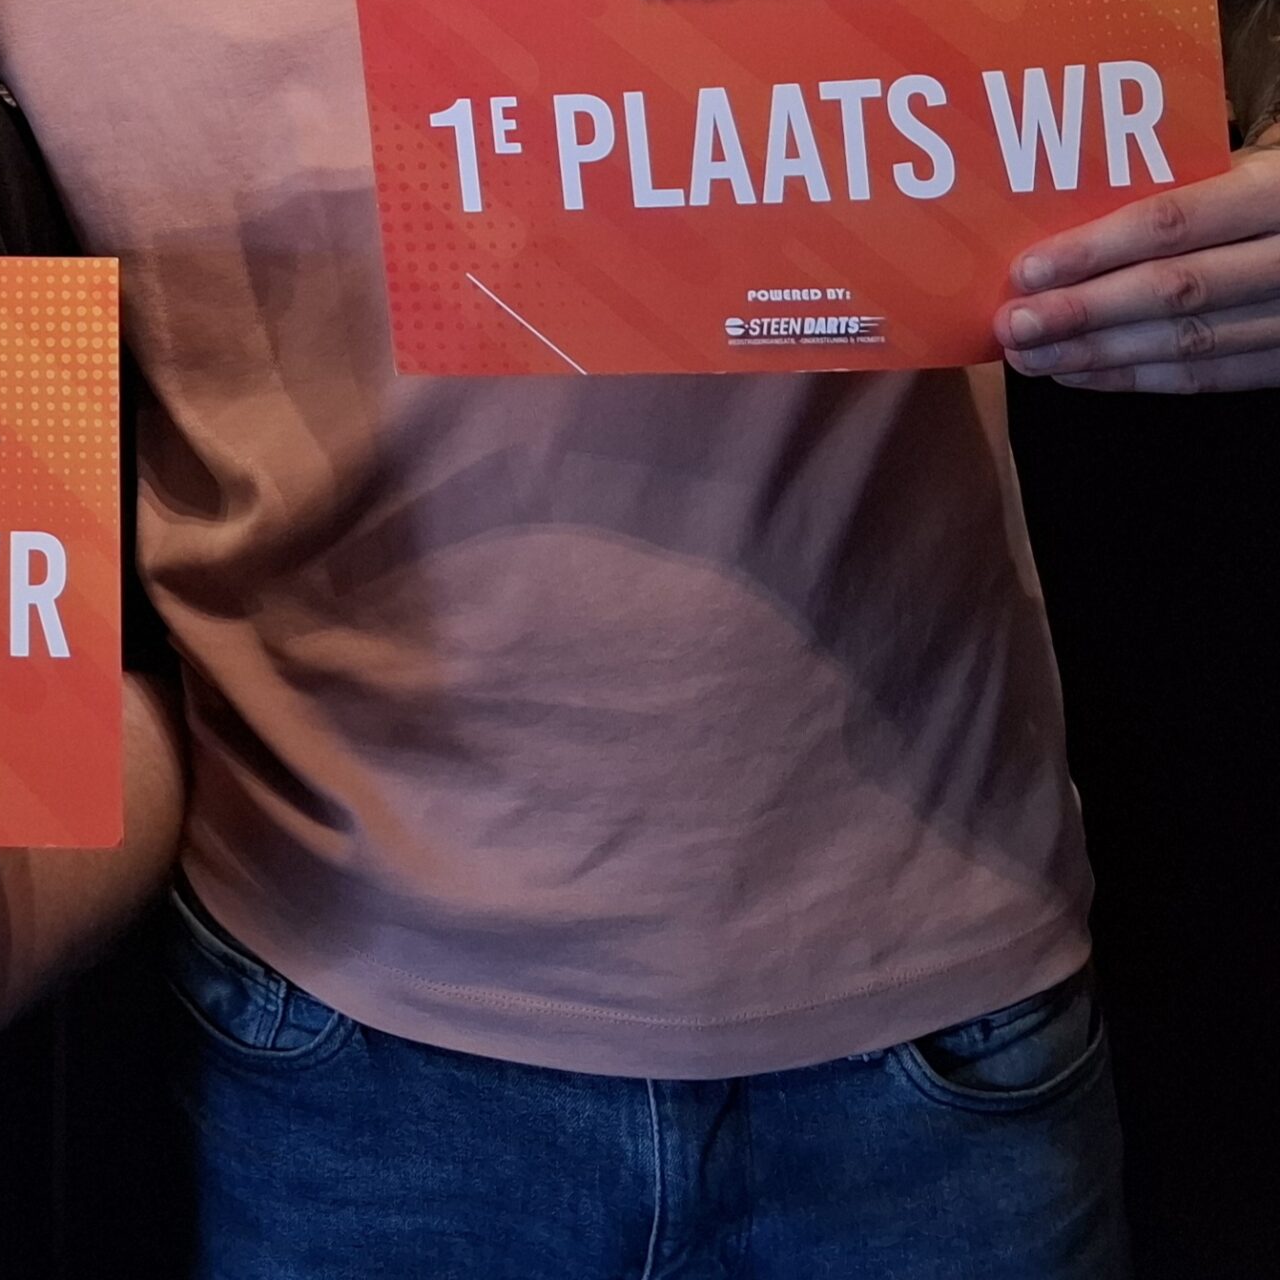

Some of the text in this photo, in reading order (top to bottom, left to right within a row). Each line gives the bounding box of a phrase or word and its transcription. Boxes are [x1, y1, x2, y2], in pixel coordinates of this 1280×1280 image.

[429, 60, 1175, 213] 1E PLAATS WR
[747, 288, 851, 302] POWERED BY:
